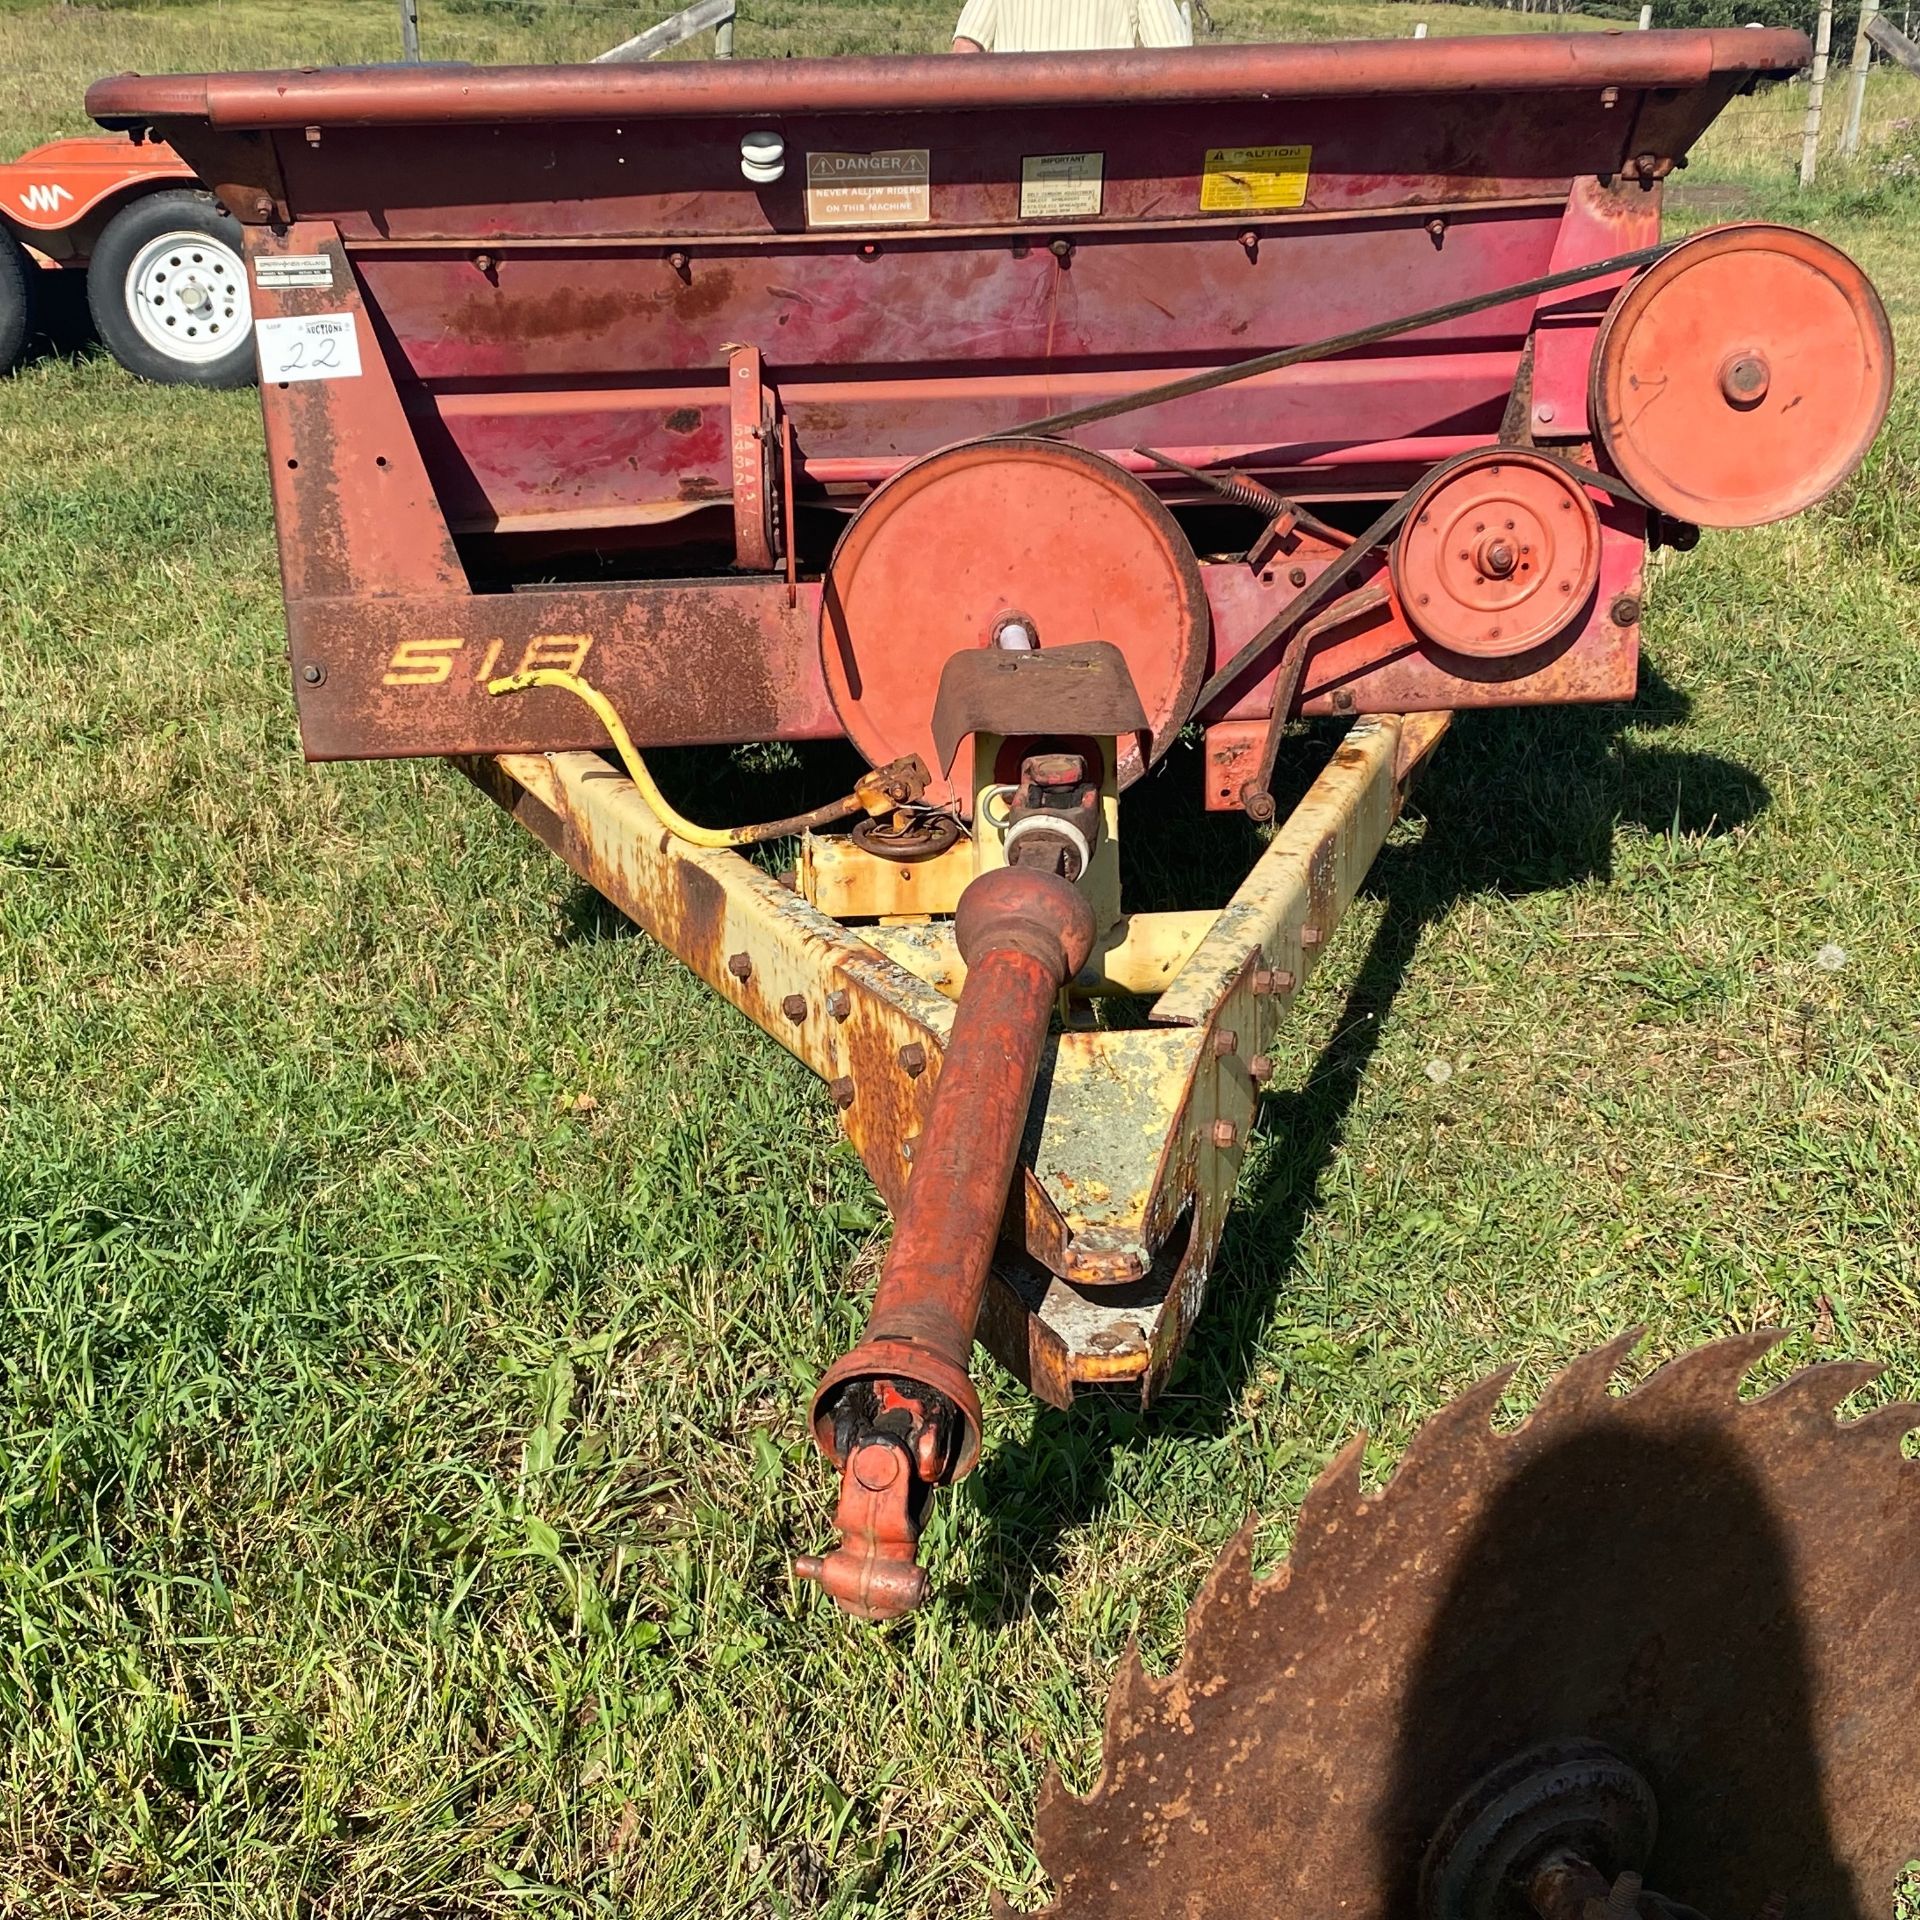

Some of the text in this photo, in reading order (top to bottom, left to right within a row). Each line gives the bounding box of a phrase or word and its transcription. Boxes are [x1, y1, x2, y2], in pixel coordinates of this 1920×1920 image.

[1040, 155, 1086, 164] IMPORTANT
[1233, 147, 1301, 159] CAUTION
[835, 157, 901, 170] DANGER
[816, 185, 922, 198] NEVER ALLOW RIDERS
[826, 202, 912, 213] ON THIS MACHINE
[280, 338, 341, 372] 22
[738, 367, 750, 378] C
[733, 424, 746, 437] 5
[734, 439, 746, 452] 4
[734, 455, 746, 469] 3
[735, 472, 746, 486] 2
